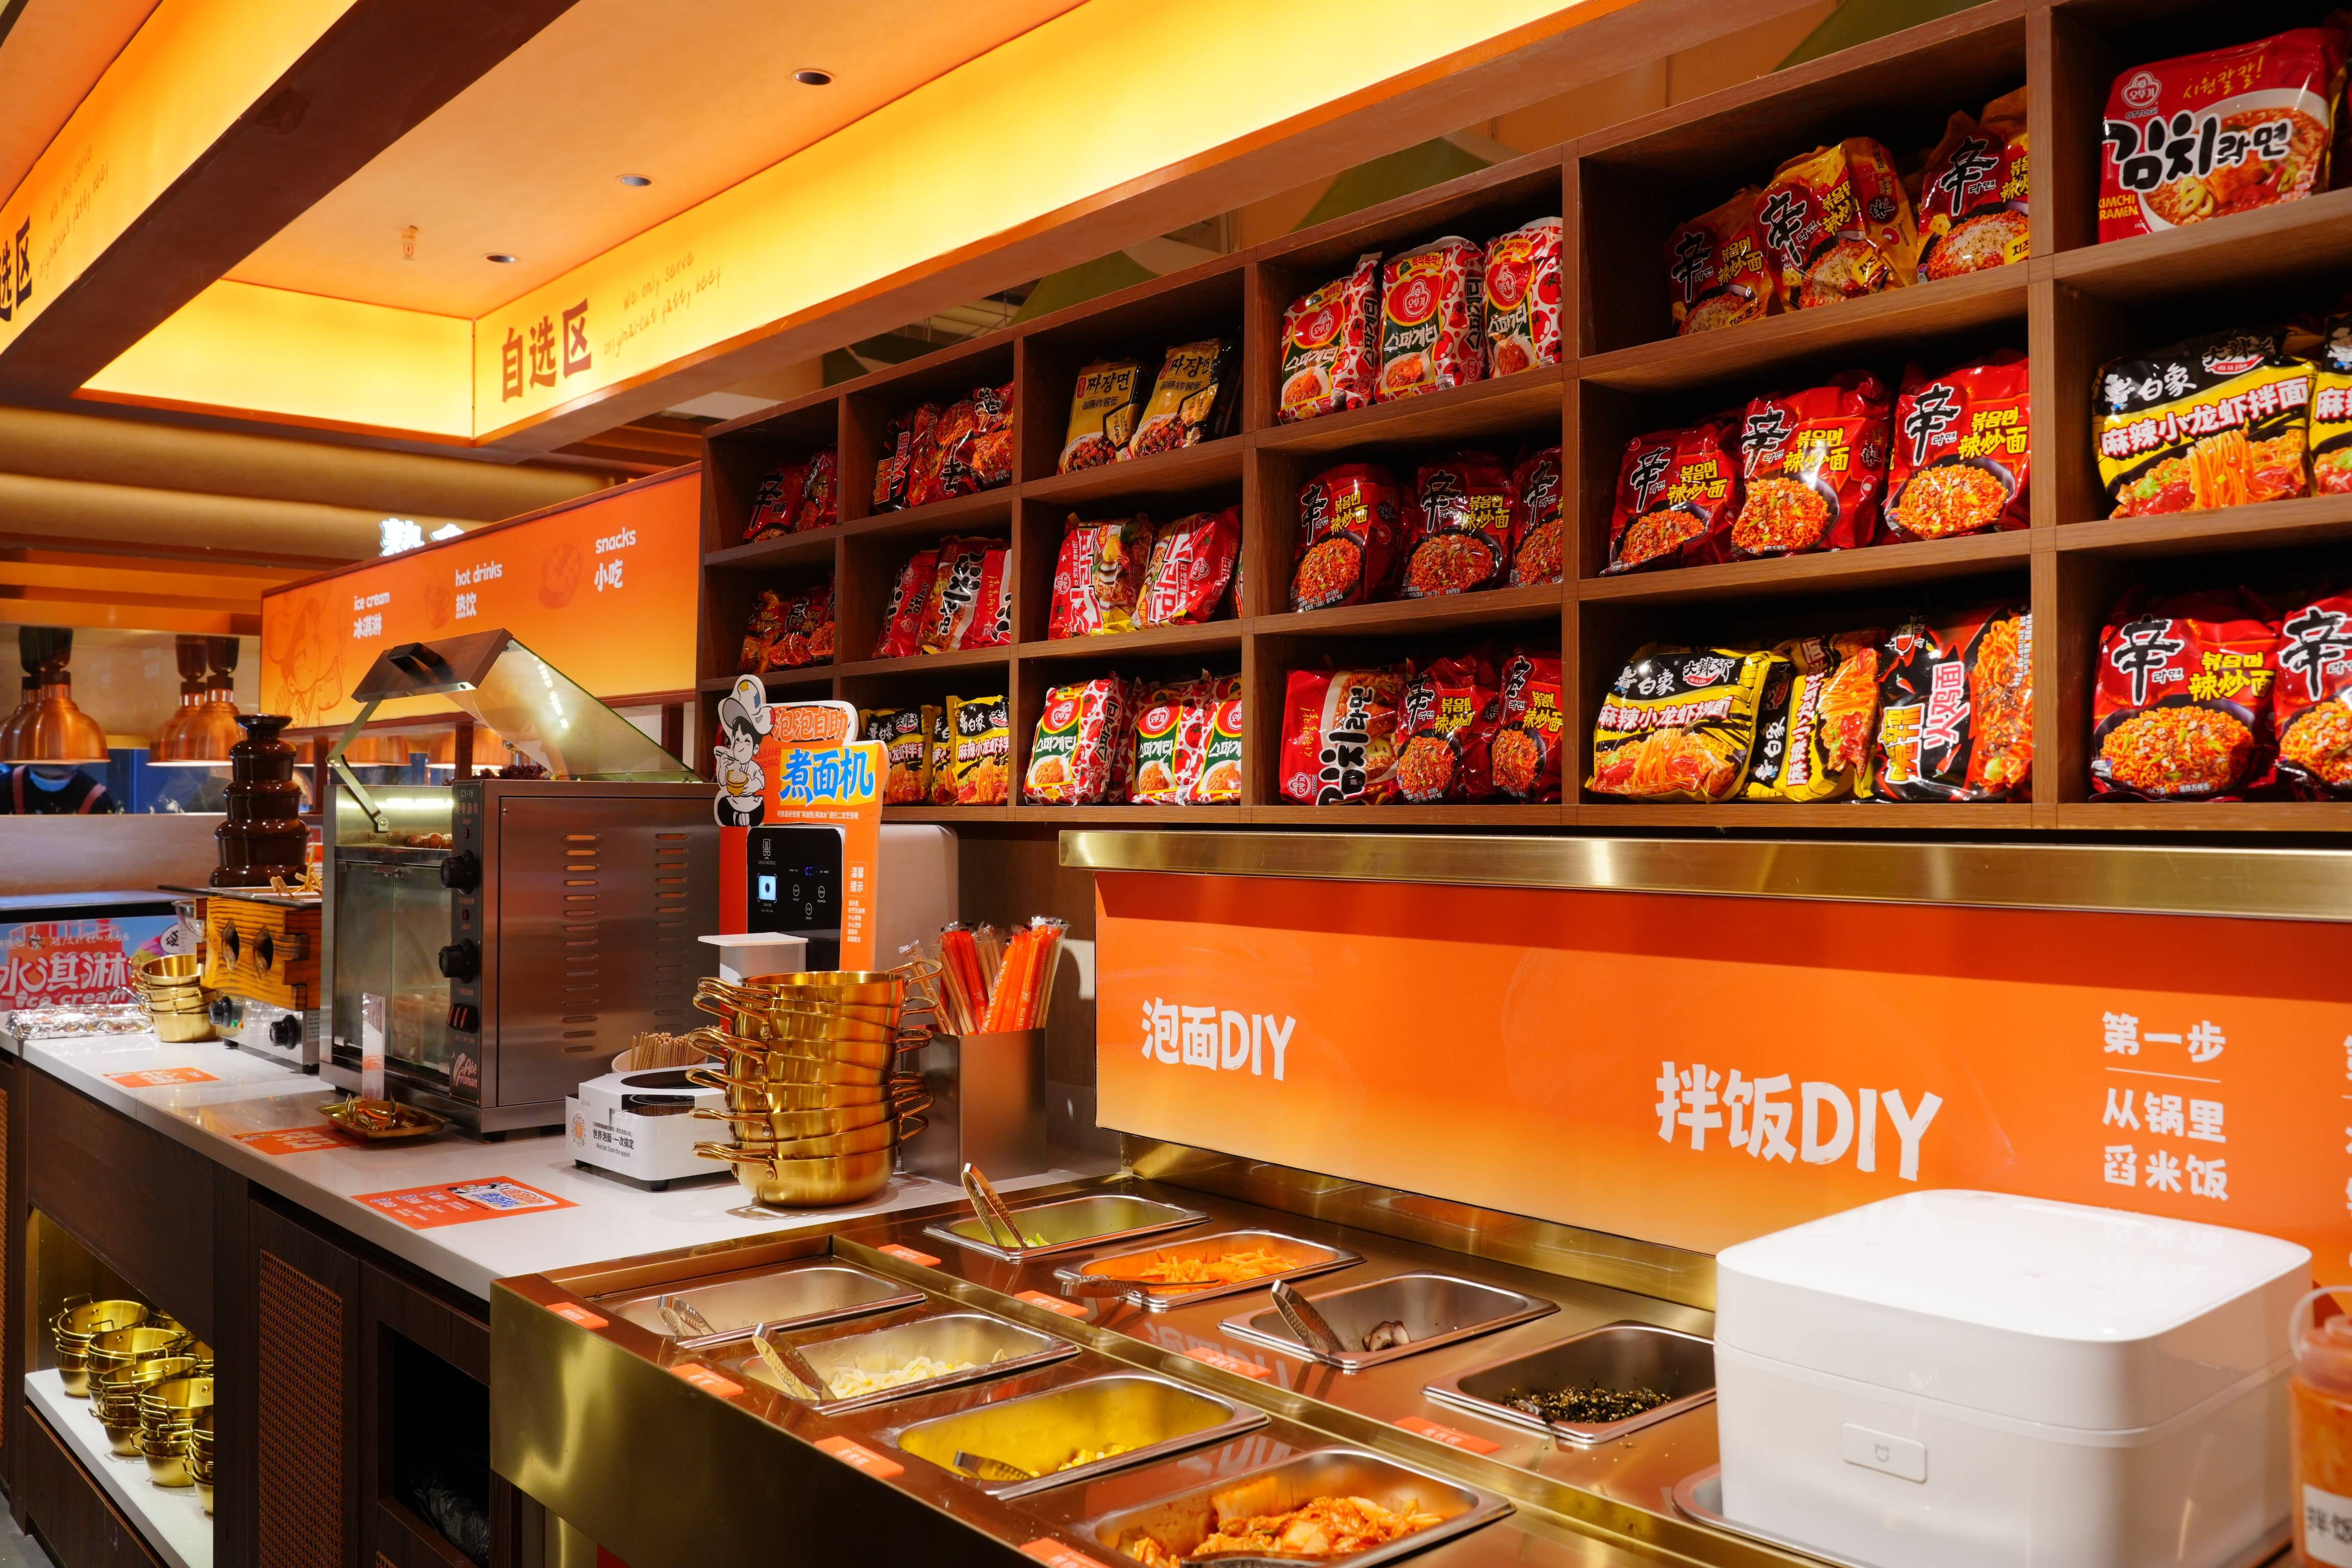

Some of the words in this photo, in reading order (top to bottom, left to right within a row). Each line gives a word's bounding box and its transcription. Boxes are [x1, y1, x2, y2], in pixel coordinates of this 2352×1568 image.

[2183, 54, 2265, 100] 시원칼칼!
[2129, 86, 2155, 101] 오뚜기
[2125, 107, 2159, 119] OTTOGI
[2102, 109, 2293, 193] 김치라면
[1940, 136, 1999, 217] 辛
[1968, 179, 1997, 195] 라면
[2099, 206, 2138, 220] RAMEN
[1759, 190, 1808, 267] 辛
[1721, 236, 1752, 262] 볶음면
[642, 275, 659, 298] only
[665, 251, 694, 283] serve
[1671, 231, 1713, 304] 辛
[1717, 250, 1763, 286] 辣炒面
[604, 308, 657, 358] original-cut
[662, 288, 691, 325] fatty
[696, 266, 722, 290] beef
[1408, 298, 1426, 309] 오뚜기
[1363, 297, 1378, 368] 스파게티
[1383, 324, 1438, 352] 스파게티
[502, 298, 592, 403] 自选区
[1285, 346, 1340, 372] 스파게티
[1169, 354, 1210, 379] 짜장면
[1086, 370, 1131, 395] 짜장면
[2138, 362, 2197, 402] 白象
[1904, 382, 1962, 467] 辛
[1970, 405, 2020, 433] 볶음면
[2101, 377, 2309, 456] 麻辣小龙虾拌面
[1741, 405, 1793, 479] 辛
[1796, 428, 1844, 449] 볶음면
[1931, 430, 1958, 447] 라면
[1957, 425, 2028, 461] 辣炒面
[892, 431, 911, 483] 火鸡面
[1762, 448, 1785, 463] 라면
[1782, 446, 1851, 474] 辣炒面
[1630, 446, 1671, 514] 辛
[1679, 459, 1718, 484] 볶음면
[1335, 489, 1361, 512] 볶음면
[1468, 494, 1505, 509] 볶음면
[1523, 460, 1558, 526] 辛
[1539, 494, 1557, 508] 라면
[1649, 480, 1666, 495] 라면
[1667, 478, 1728, 506] 辣炒面
[1301, 484, 1328, 546] 辛
[1420, 470, 1462, 534] 辛
[1315, 516, 1329, 530] 라면
[1330, 503, 1369, 535] 辣炒面
[1459, 509, 1510, 531] 辣炒面
[595, 527, 636, 554] snacks
[455, 567, 470, 587] hot
[473, 561, 503, 584] drinks
[594, 560, 624, 592] 小吃
[354, 595, 364, 611] ice
[366, 591, 390, 608] cream
[455, 592, 477, 620] 热饮
[354, 613, 382, 640] 冰淇淋
[2111, 614, 2185, 706] 辛
[2201, 651, 2264, 671] 볶음면
[2279, 605, 2352, 702] 辛
[1637, 668, 1676, 696] 白象
[2151, 667, 2185, 683] 라면
[2187, 669, 2275, 702] 辣炒面
[1405, 671, 1435, 736] 辛
[1440, 695, 1472, 712] 볶음면
[1499, 655, 1532, 725] 辛
[1532, 691, 1558, 709] 볶음면
[1054, 709, 1072, 722] 오뚜기
[1149, 714, 1166, 724] 오뚜기
[1418, 709, 1434, 721] 라면
[1509, 700, 1526, 712] 라면
[1598, 696, 1733, 731] 麻辣小龙虾拌面
[1786, 637, 1825, 787] 麻辣小龙虾拌面
[1923, 660, 1971, 750] 火鸡面
[772, 705, 849, 743] 泡泡自助
[968, 713, 986, 731] 白象
[1094, 700, 1119, 763] 스파게티
[1300, 706, 1319, 758] 시원칼칼!
[1433, 709, 1477, 734] 辣炒面
[1522, 707, 1563, 733] 辣炒面
[1035, 734, 1078, 753] 스파게티
[1138, 739, 1174, 758] 스파게티
[1316, 684, 1374, 805] 김치라면
[778, 746, 876, 808] 煮面机
[850, 880, 864, 893] 提示
[851, 867, 864, 879] 温馨
[59, 989, 127, 1006] cream
[1141, 996, 1296, 1081] 泡面DIY
[2102, 1011, 2226, 1063] 第一步
[465, 1058, 477, 1076] Abe
[1655, 1061, 1943, 1182] 拌饭DIY
[2102, 1088, 2226, 1143] 从锅里
[2104, 1144, 2228, 1201] 舀米饭
